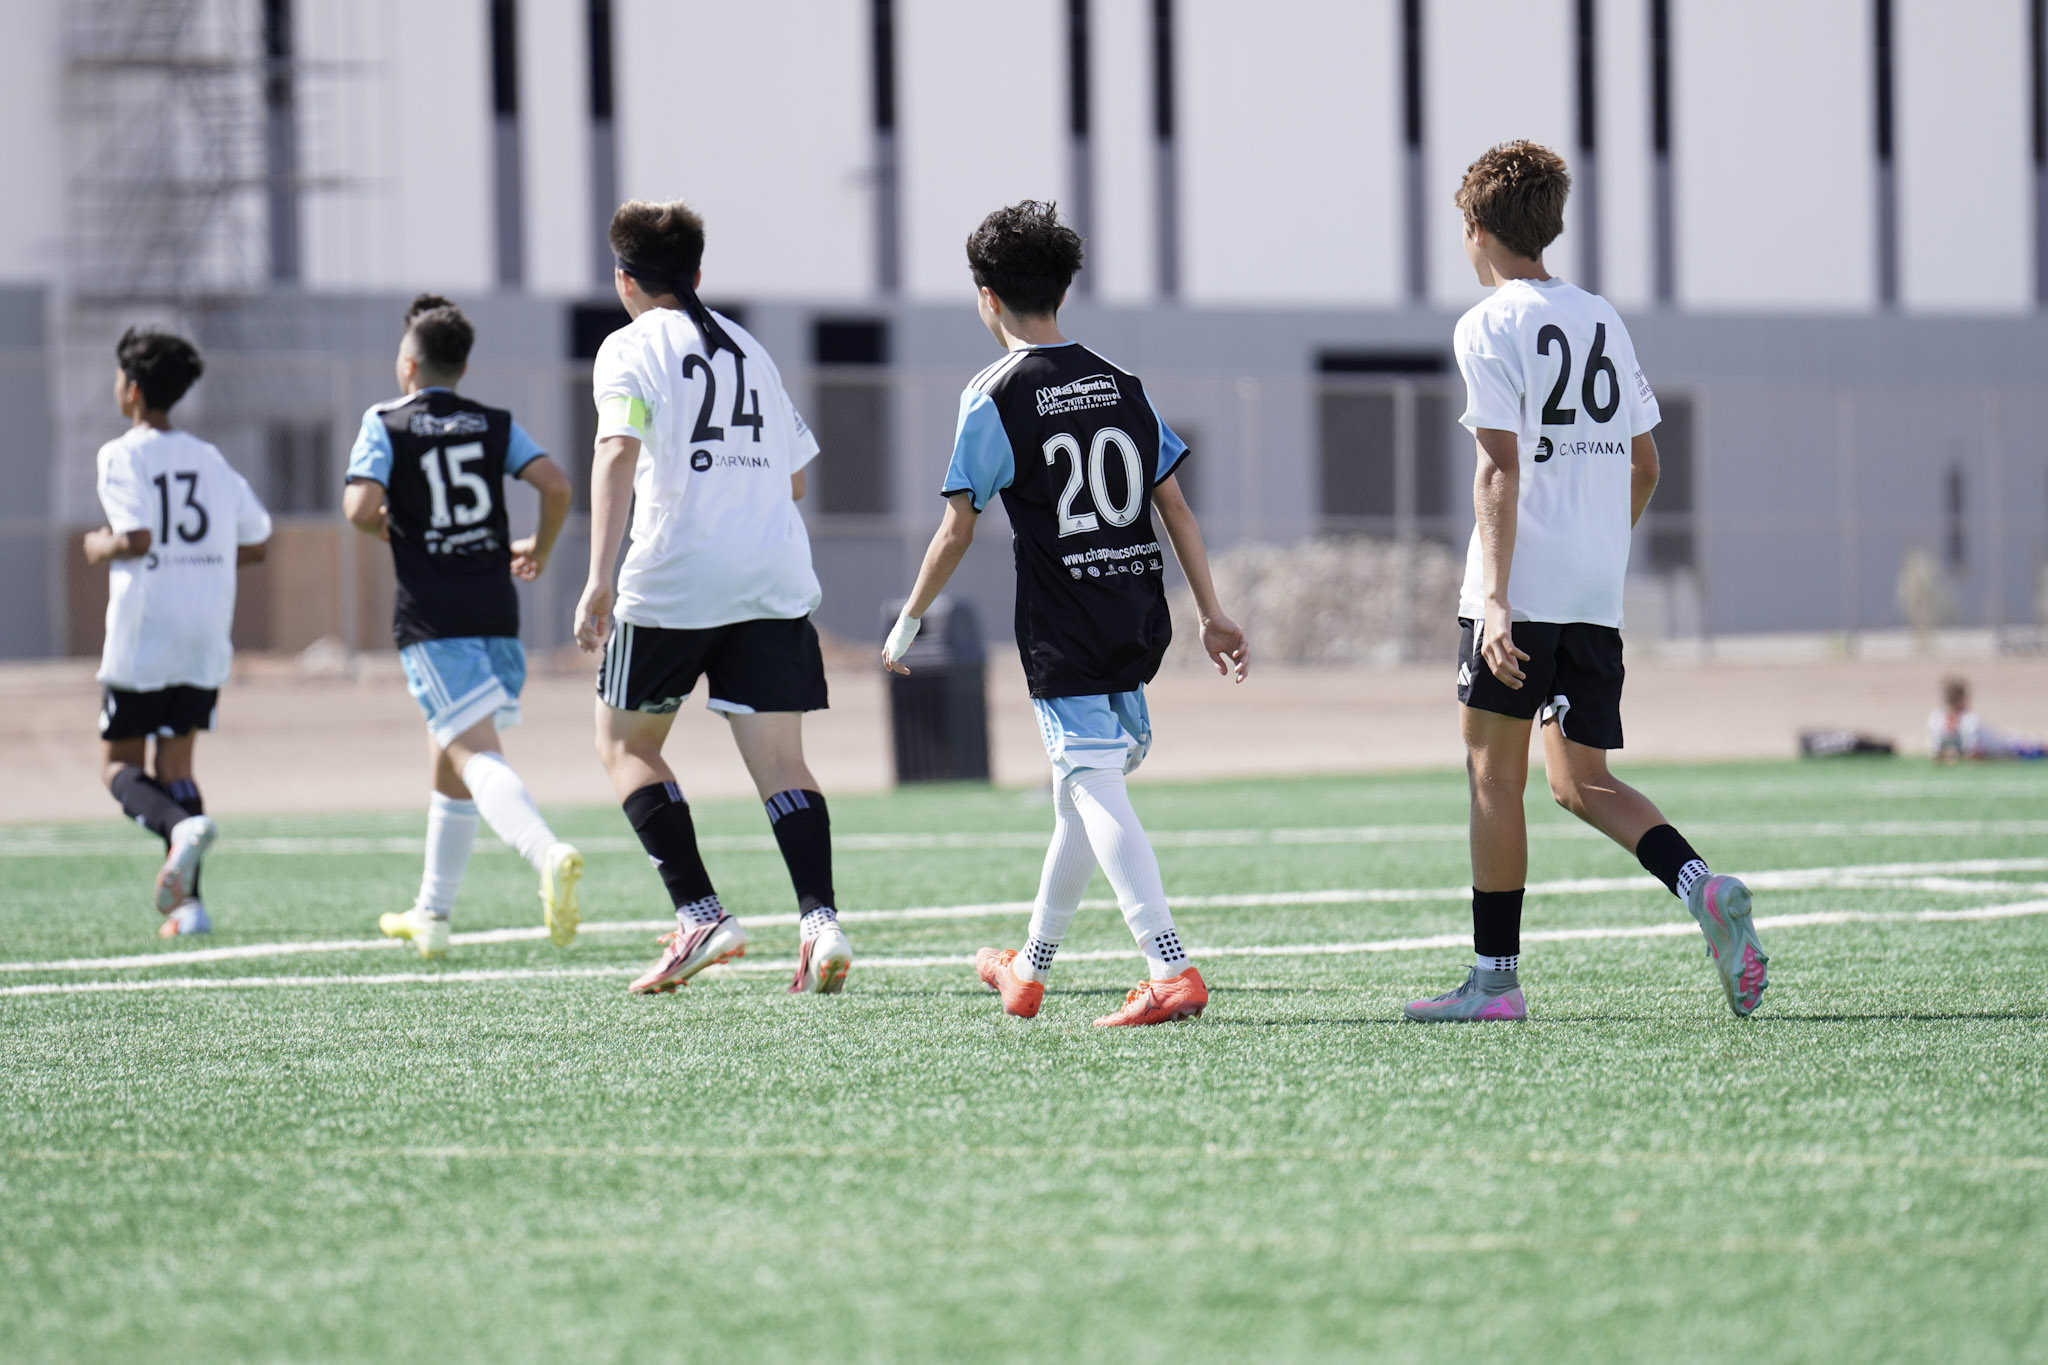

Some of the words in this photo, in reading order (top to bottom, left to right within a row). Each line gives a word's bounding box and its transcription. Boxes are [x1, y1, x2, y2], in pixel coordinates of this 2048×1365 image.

[682, 353, 764, 444] 24
[1050, 385, 1073, 397] Dias
[1072, 380, 1100, 394] Mgmt
[1537, 322, 1620, 424] 26
[419, 441, 492, 528] 15
[715, 454, 770, 468] CARVANA
[1042, 427, 1144, 538] 20
[1559, 442, 1625, 456] CARVANA
[153, 470, 209, 545] 13
